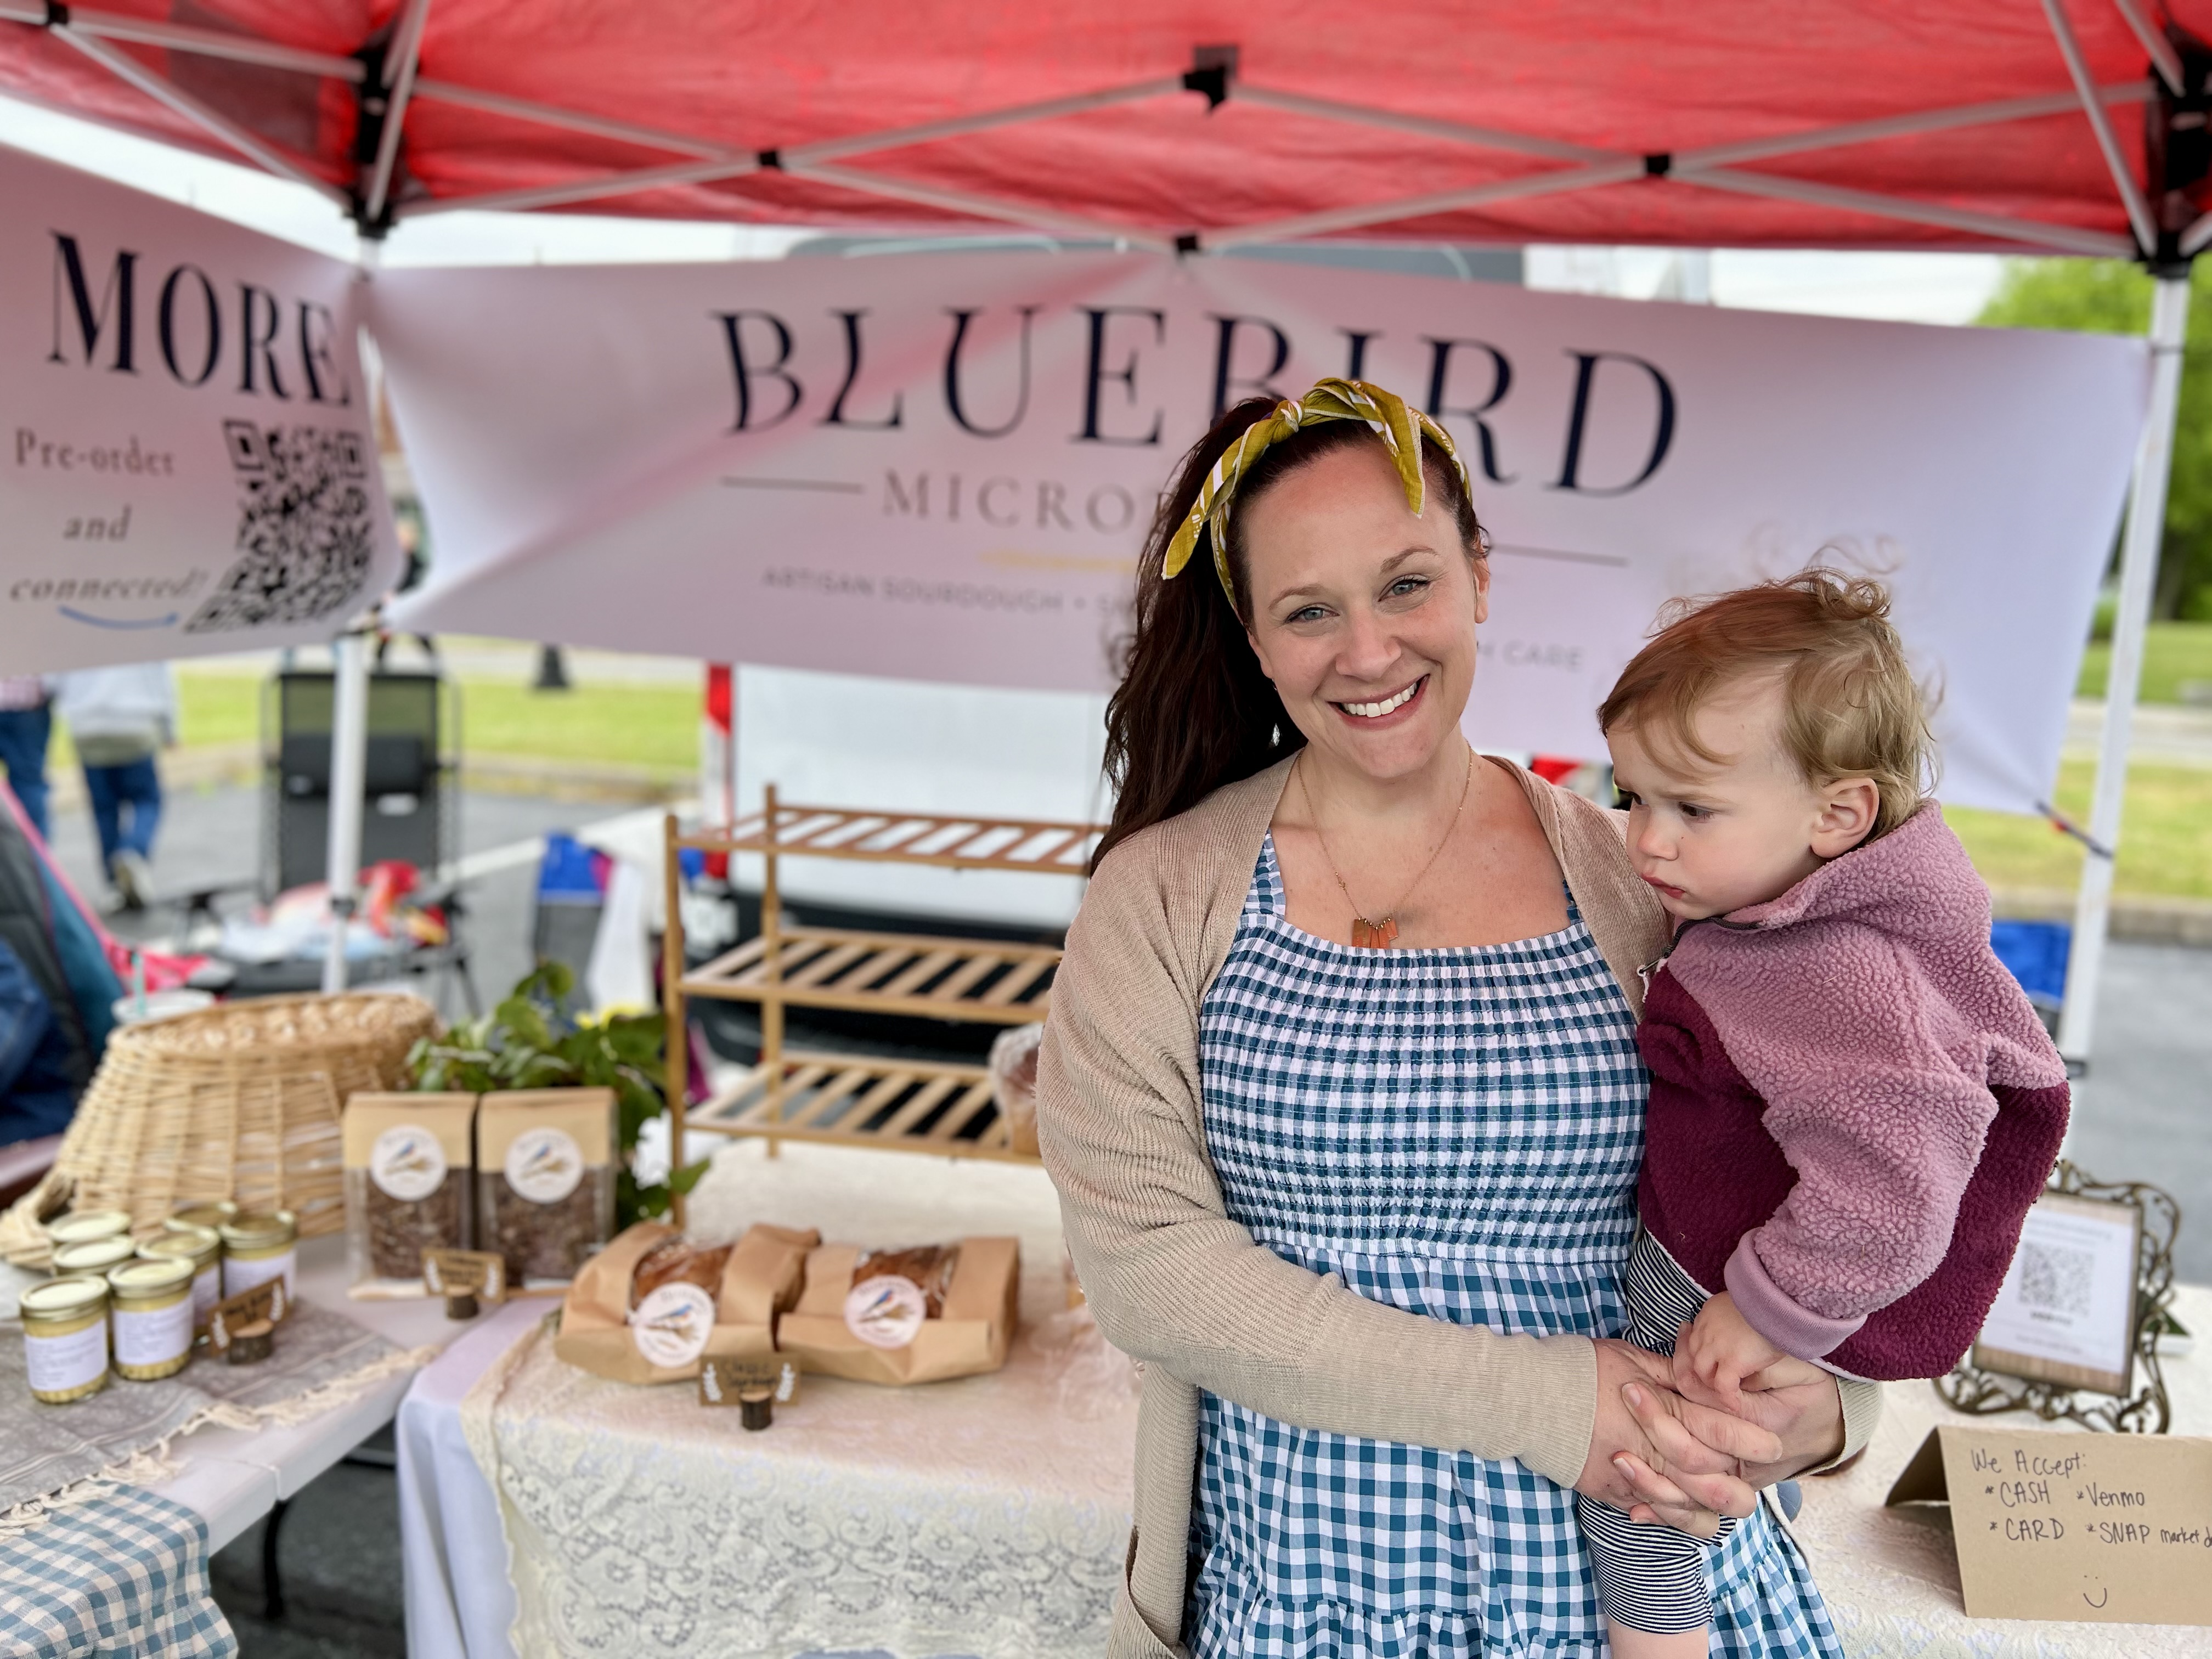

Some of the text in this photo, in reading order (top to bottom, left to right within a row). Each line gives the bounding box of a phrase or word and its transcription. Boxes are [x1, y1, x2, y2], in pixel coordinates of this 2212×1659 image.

[46, 230, 352, 407] MORE
[15, 426, 176, 477] Pre-order
[63, 501, 133, 542] and
[879, 467, 1148, 537] MICRO
[761, 565, 875, 597] ARTISAN
[880, 574, 1064, 616] SOURDOUGH
[1971, 1448, 2087, 1480] We Accept:
[2159, 1526, 2200, 1545] market
